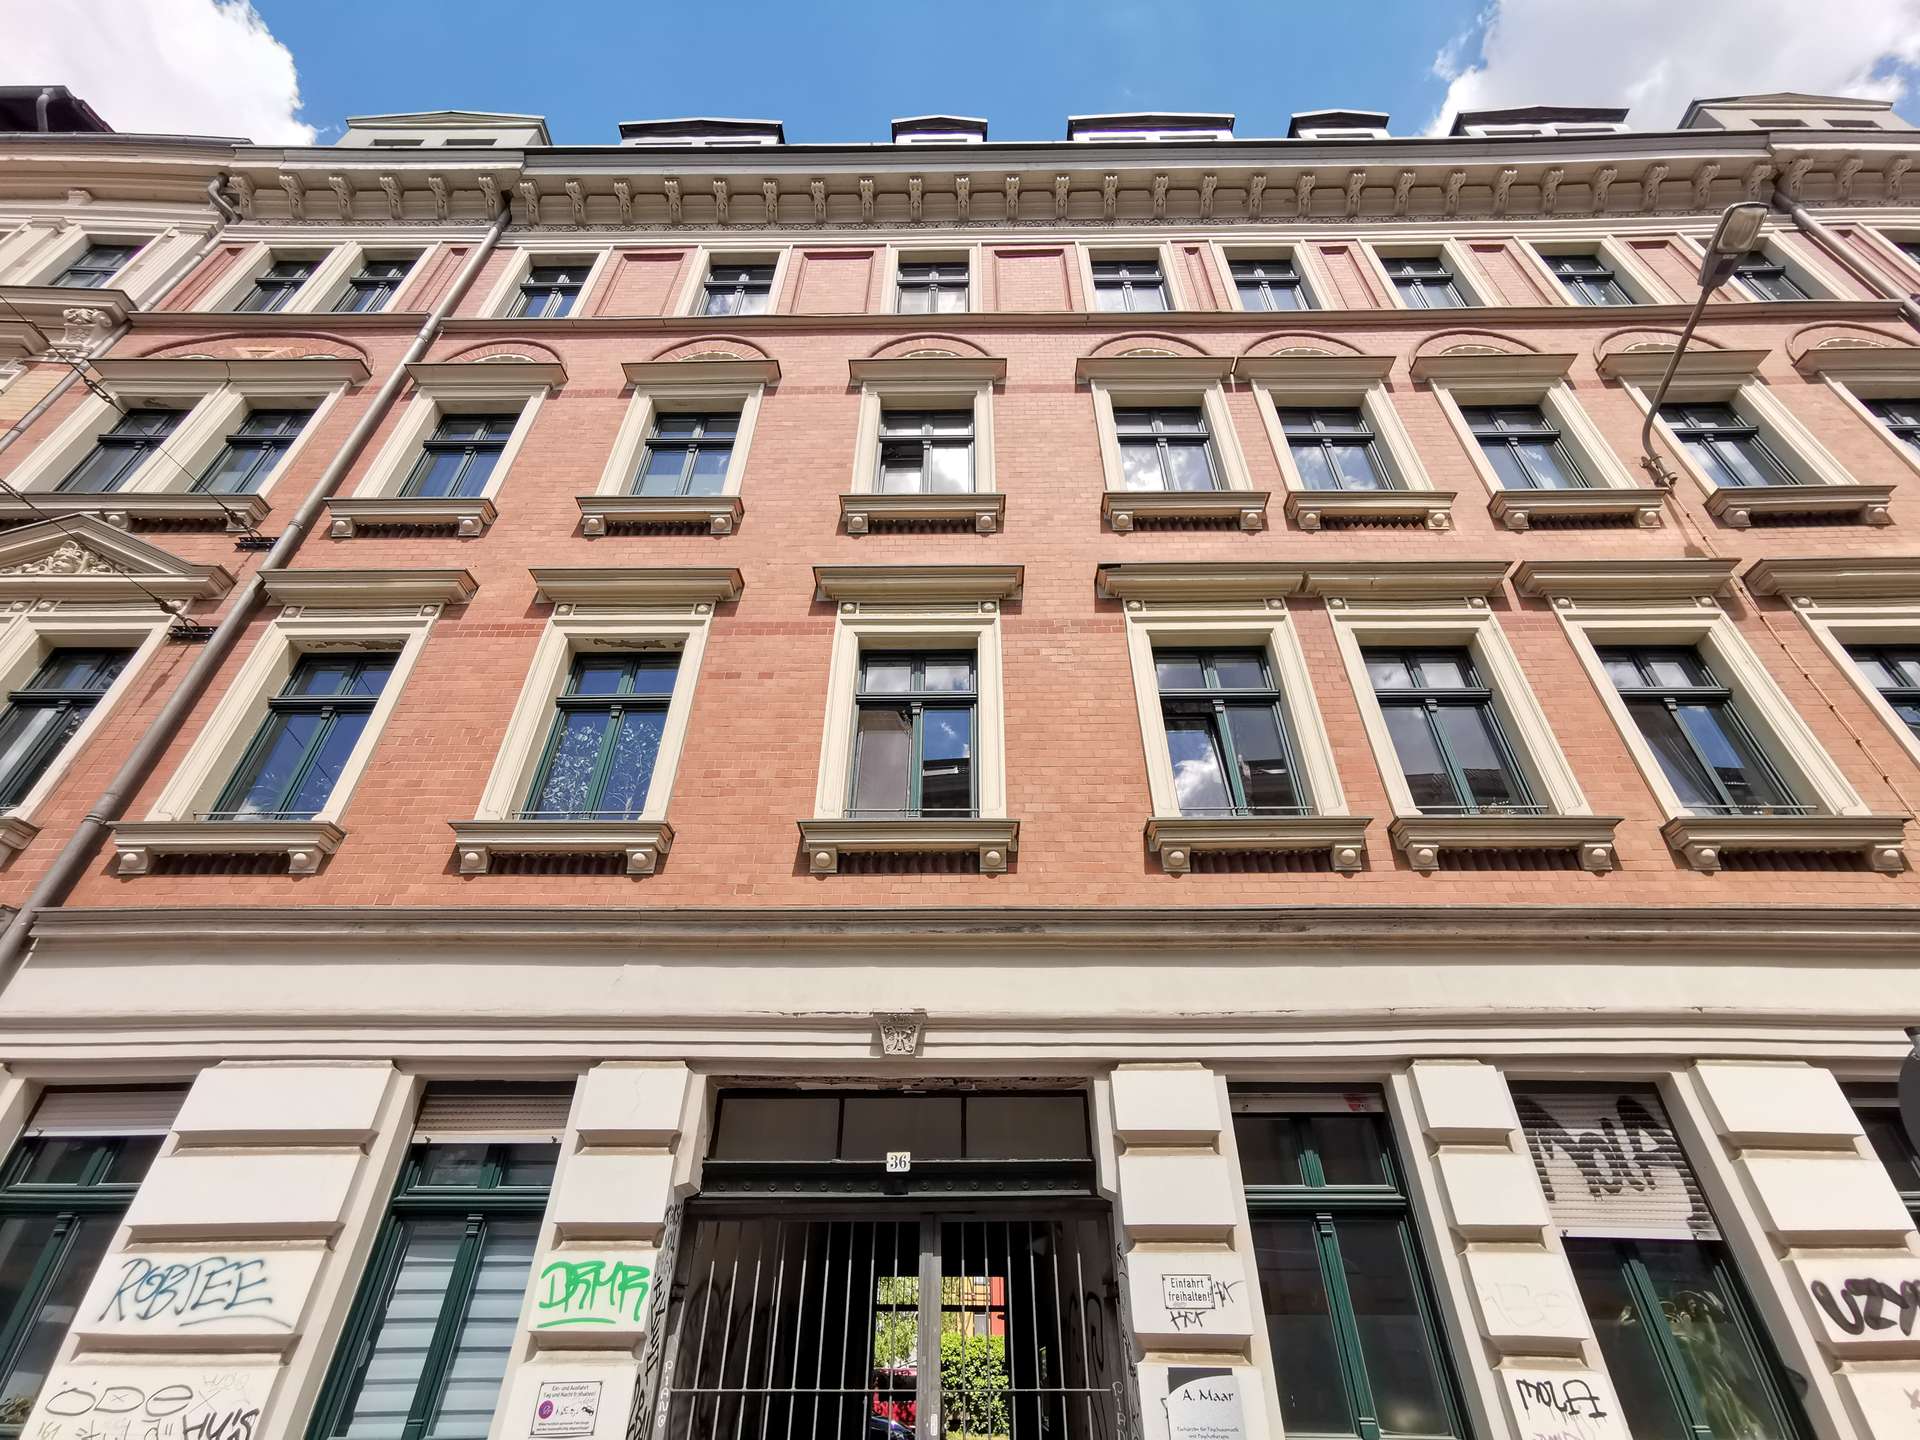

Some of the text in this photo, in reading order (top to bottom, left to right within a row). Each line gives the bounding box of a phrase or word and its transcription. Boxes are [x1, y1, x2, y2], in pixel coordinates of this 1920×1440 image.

[890, 1154, 907, 1169] 36
[1170, 1278, 1204, 1288] Einfahrt
[1168, 1291, 1211, 1301] freihalten!
[1183, 1389, 1234, 1402] A. Maar
